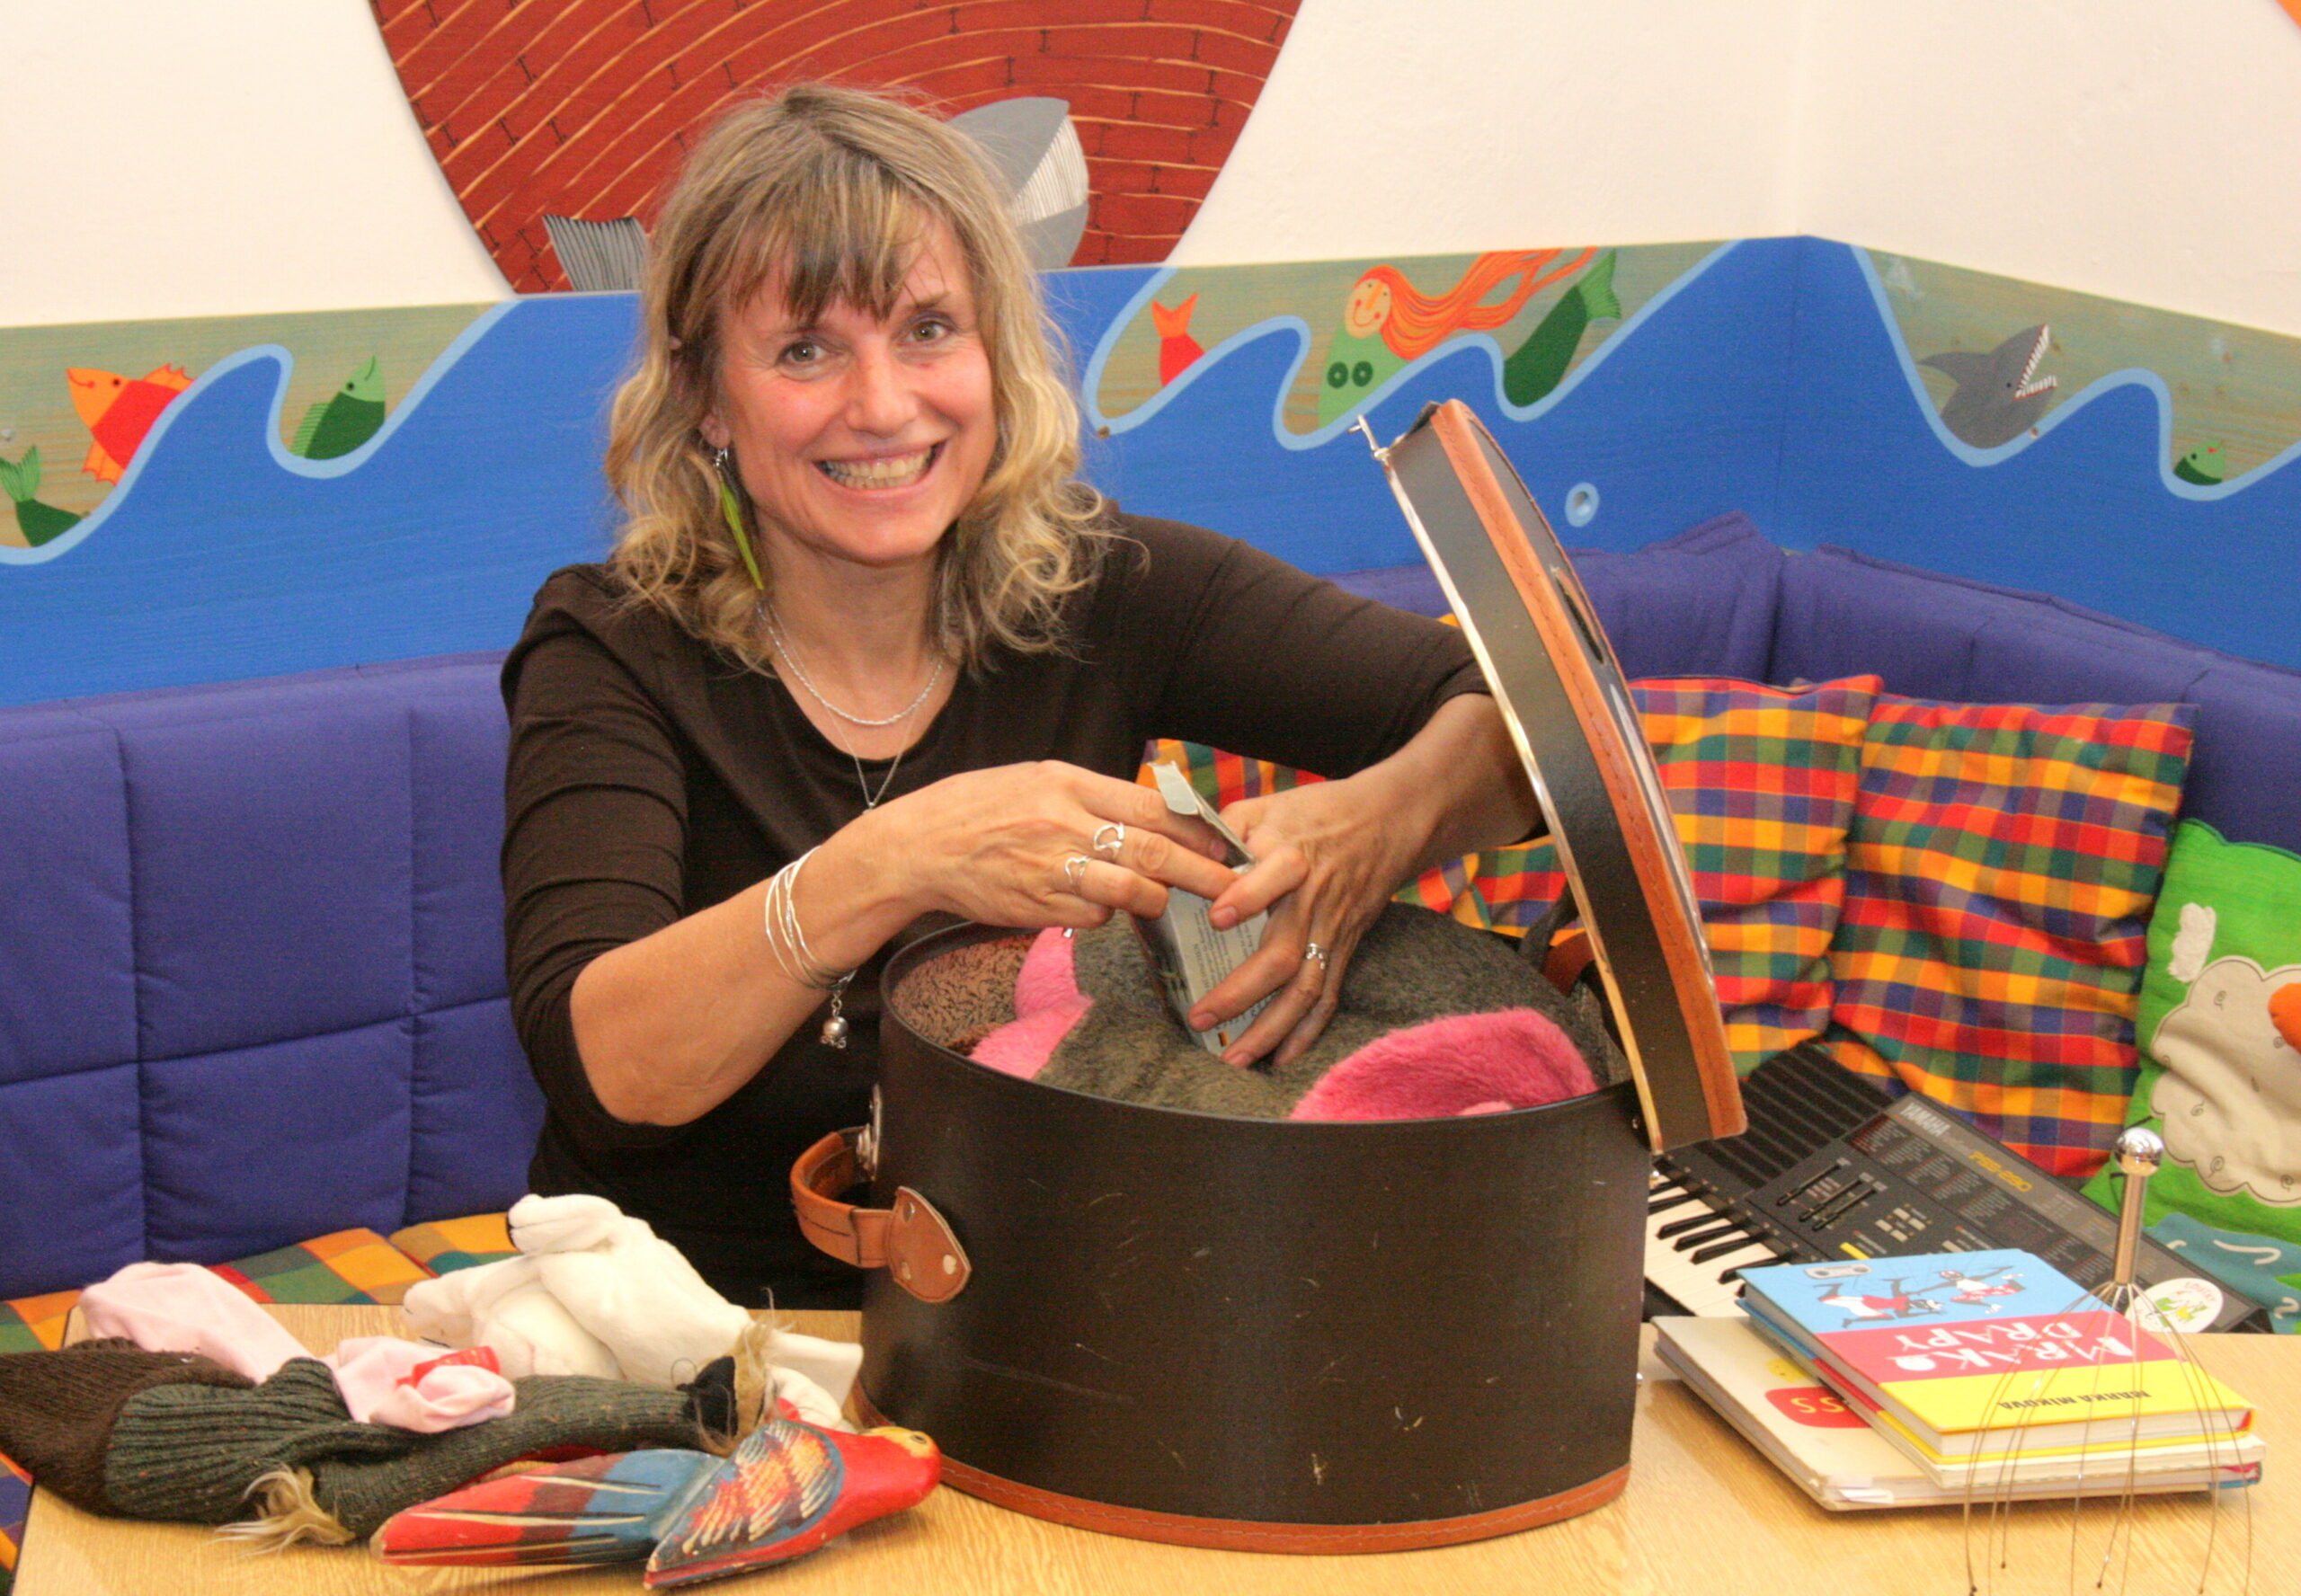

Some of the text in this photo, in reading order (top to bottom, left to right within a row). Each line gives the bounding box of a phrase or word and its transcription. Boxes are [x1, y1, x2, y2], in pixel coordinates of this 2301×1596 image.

[1899, 1102, 1951, 1138] YAMAHA
[1894, 1321, 2083, 1352] DRAPY
[2077, 1389, 2153, 1404] MARKA
